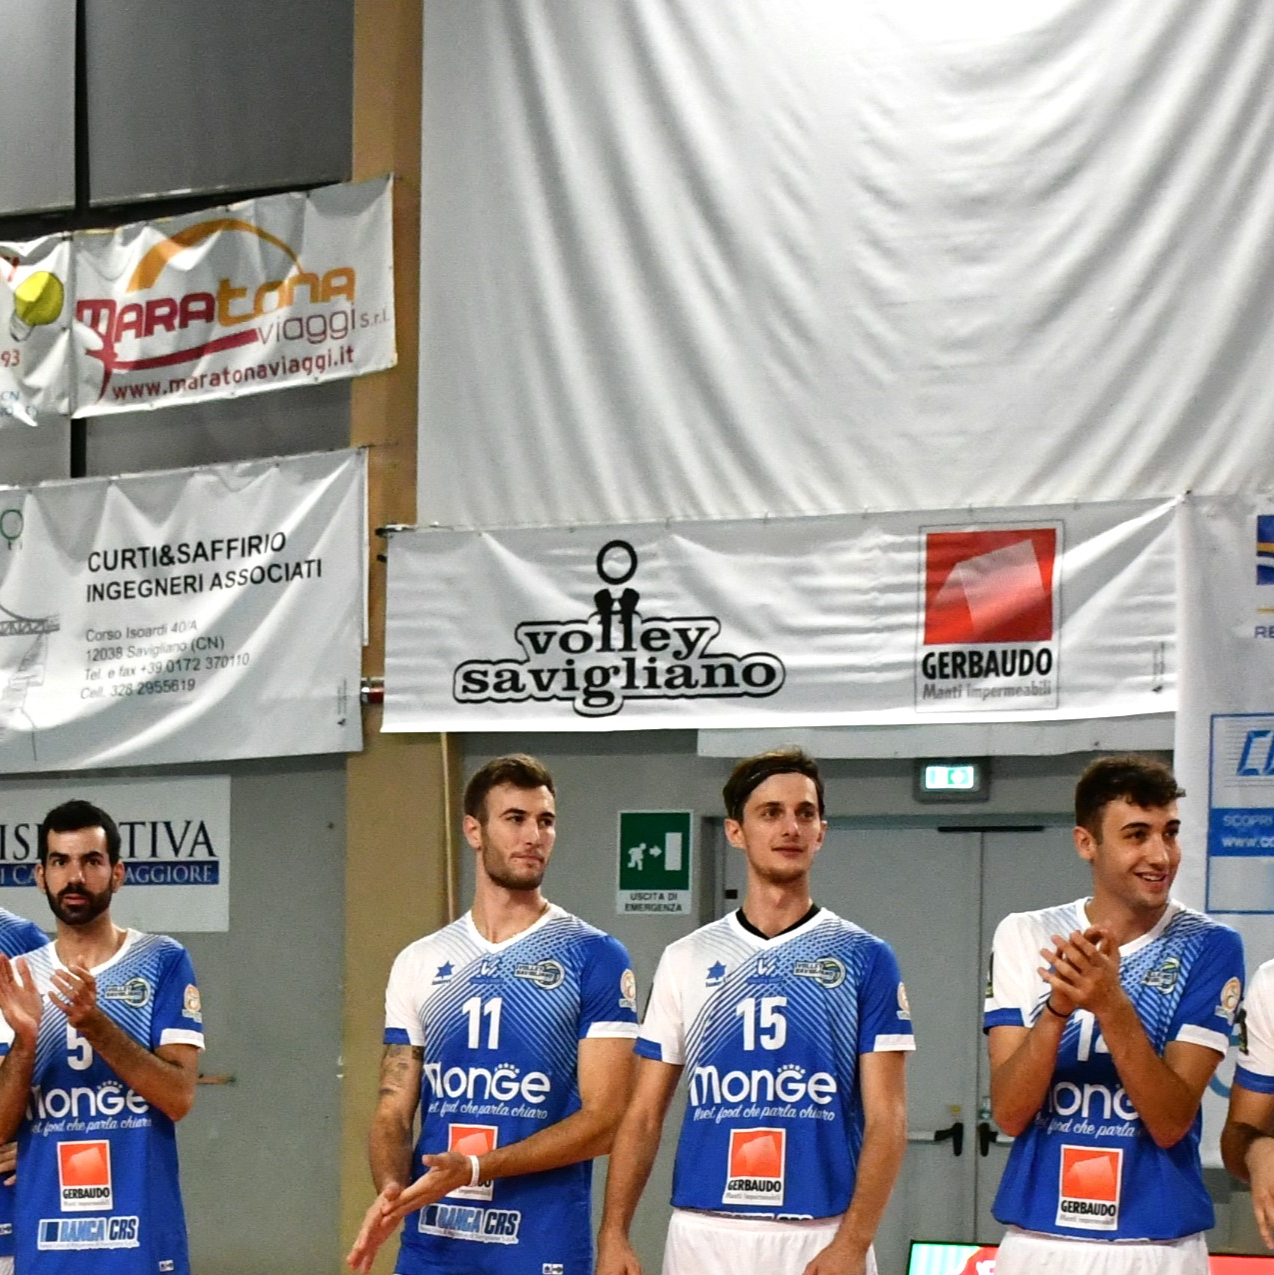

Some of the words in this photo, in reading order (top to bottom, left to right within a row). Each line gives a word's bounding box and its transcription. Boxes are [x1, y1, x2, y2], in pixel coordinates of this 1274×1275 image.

[257, 303, 356, 345] viaggi
[112, 347, 354, 399] www.maratonaviaggi.it
[88, 531, 286, 573] CURTI&SAFFIRIO
[86, 573, 204, 603] INGEGNERI
[209, 558, 322, 592] ASSOCIATI
[86, 628, 122, 643] Corso
[191, 635, 225, 654] (CN)
[524, 614, 711, 660] volley
[107, 668, 115, 679] e
[118, 665, 136, 678] fax
[166, 657, 201, 673] 0172
[922, 648, 1052, 680] GERBAUDO
[461, 656, 777, 709] savigliano
[923, 682, 962, 700] Manti
[625, 903, 683, 912] EMERGENZA
[462, 997, 502, 1049] 11
[737, 996, 787, 1050] 15
[67, 1023, 93, 1071] 5
[67, 1118, 85, 1132] che
[86, 1117, 118, 1133] parla
[716, 1105, 742, 1124] food
[743, 1104, 761, 1118] che
[761, 1104, 796, 1122] parla
[1073, 1120, 1094, 1134] che
[63, 1187, 110, 1200] GERBAUDO
[728, 1180, 781, 1193] GERBAUDO
[1061, 1200, 1116, 1216] GERBAUDO
[109, 1218, 138, 1241] CRS
[484, 1210, 519, 1235] CRS
